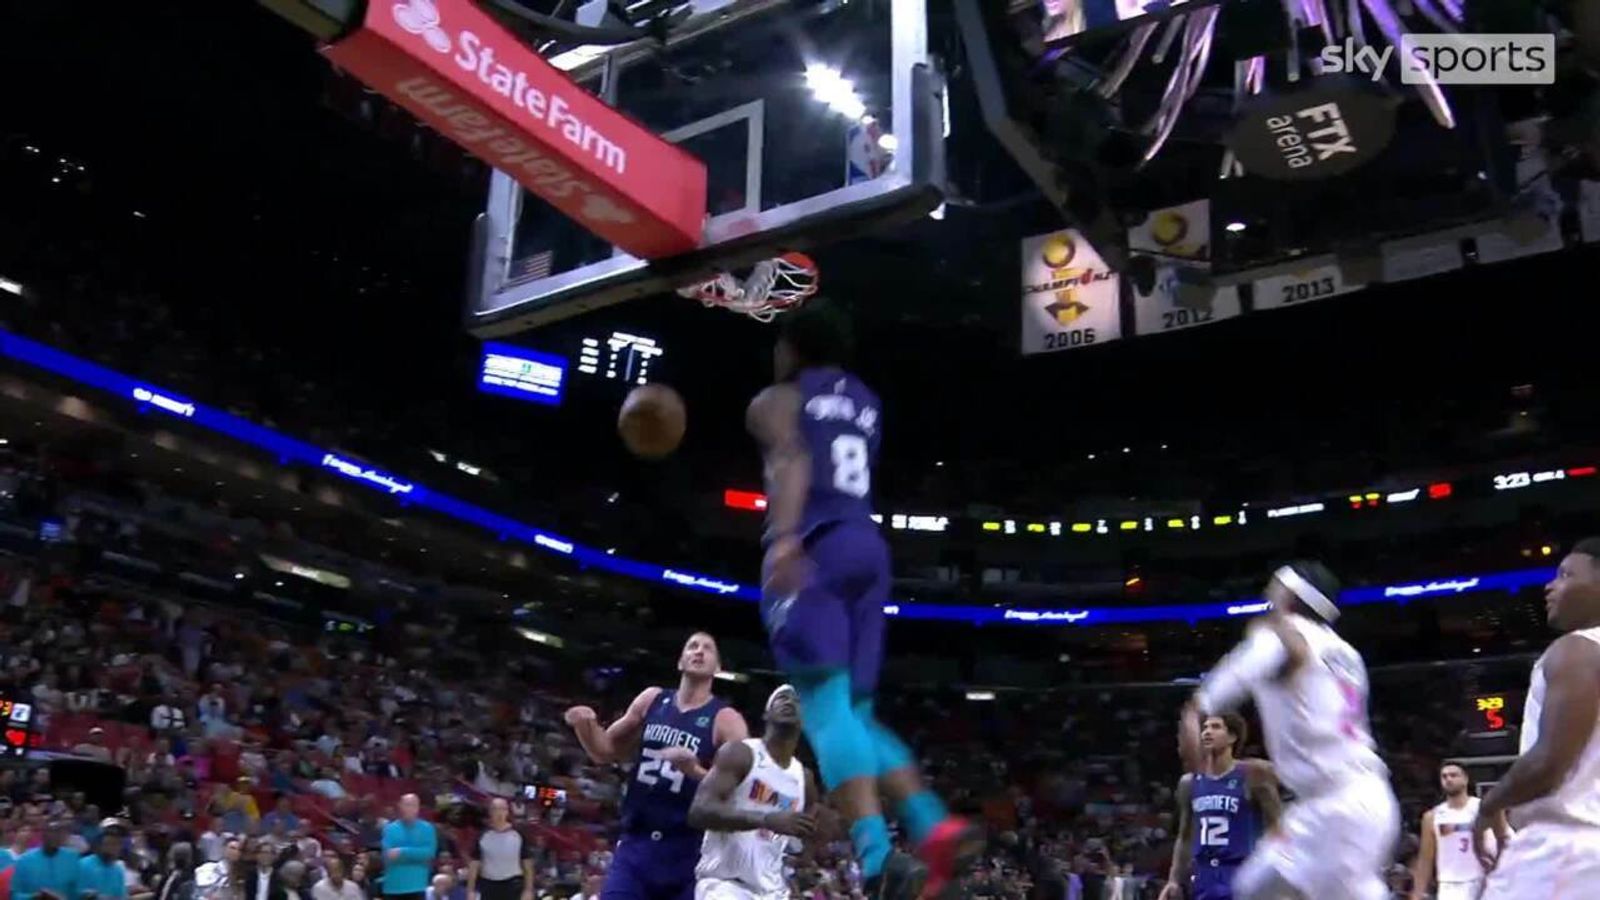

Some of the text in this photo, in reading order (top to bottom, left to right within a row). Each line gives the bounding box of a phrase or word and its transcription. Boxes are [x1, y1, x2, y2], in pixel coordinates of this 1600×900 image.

[1266, 115, 1313, 168] arena
[1296, 102, 1357, 160] FTX
[1282, 277, 1336, 303] 2013
[1162, 309, 1215, 329] 2012
[1044, 329, 1096, 349] 2006
[831, 434, 870, 497] 8
[643, 723, 701, 756] HORNETS
[637, 747, 685, 793] 24
[1200, 817, 1229, 846] 12
[1458, 837, 1469, 853] 3
